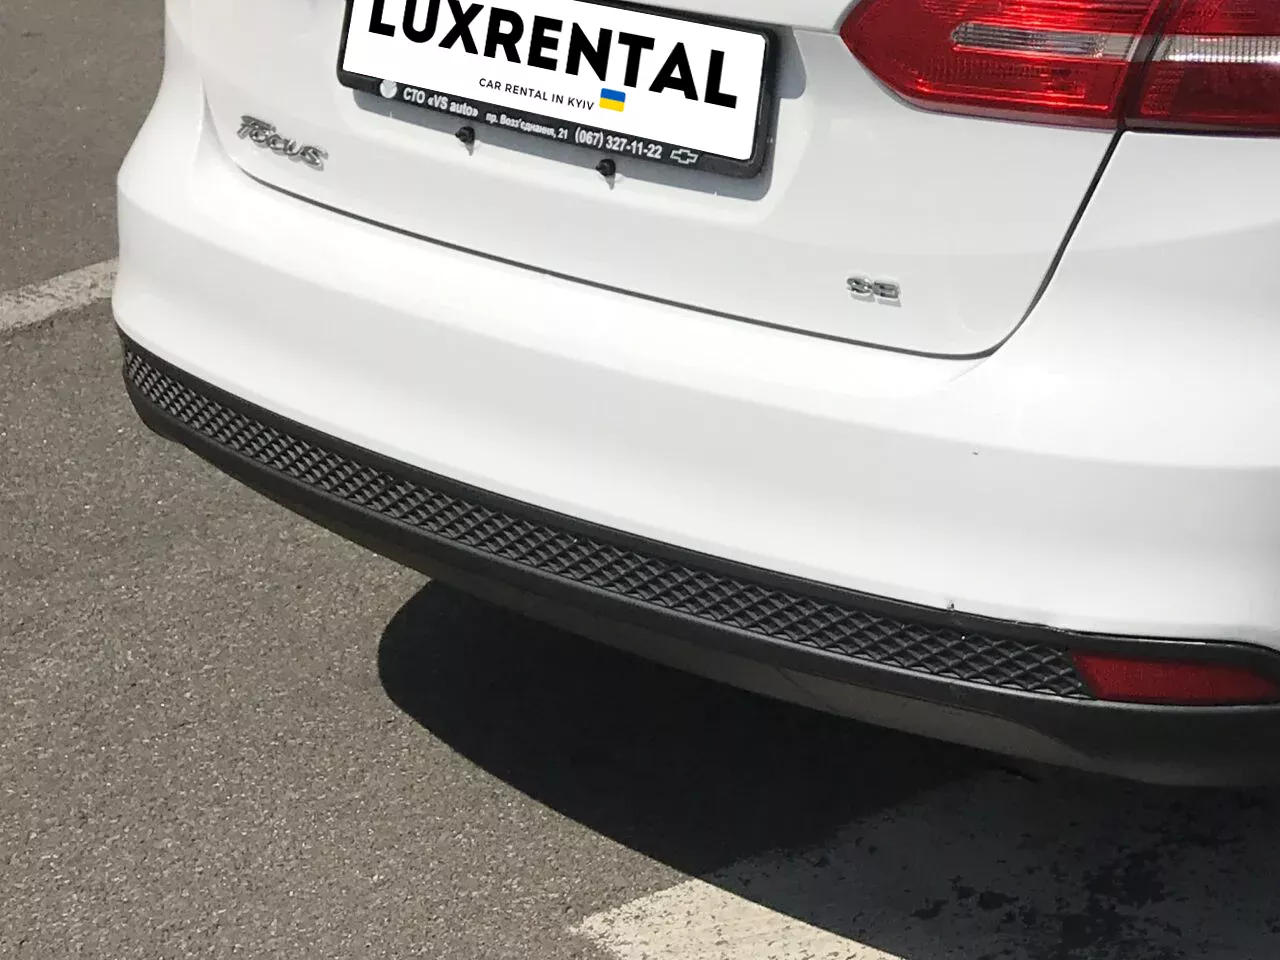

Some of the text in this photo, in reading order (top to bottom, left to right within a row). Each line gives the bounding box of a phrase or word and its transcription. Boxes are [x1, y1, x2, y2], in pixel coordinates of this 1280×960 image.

[558, 128, 569, 140] 21
[575, 127, 603, 149] (067)
[605, 133, 662, 159] 327-11-22
[846, 277, 900, 299] SE
